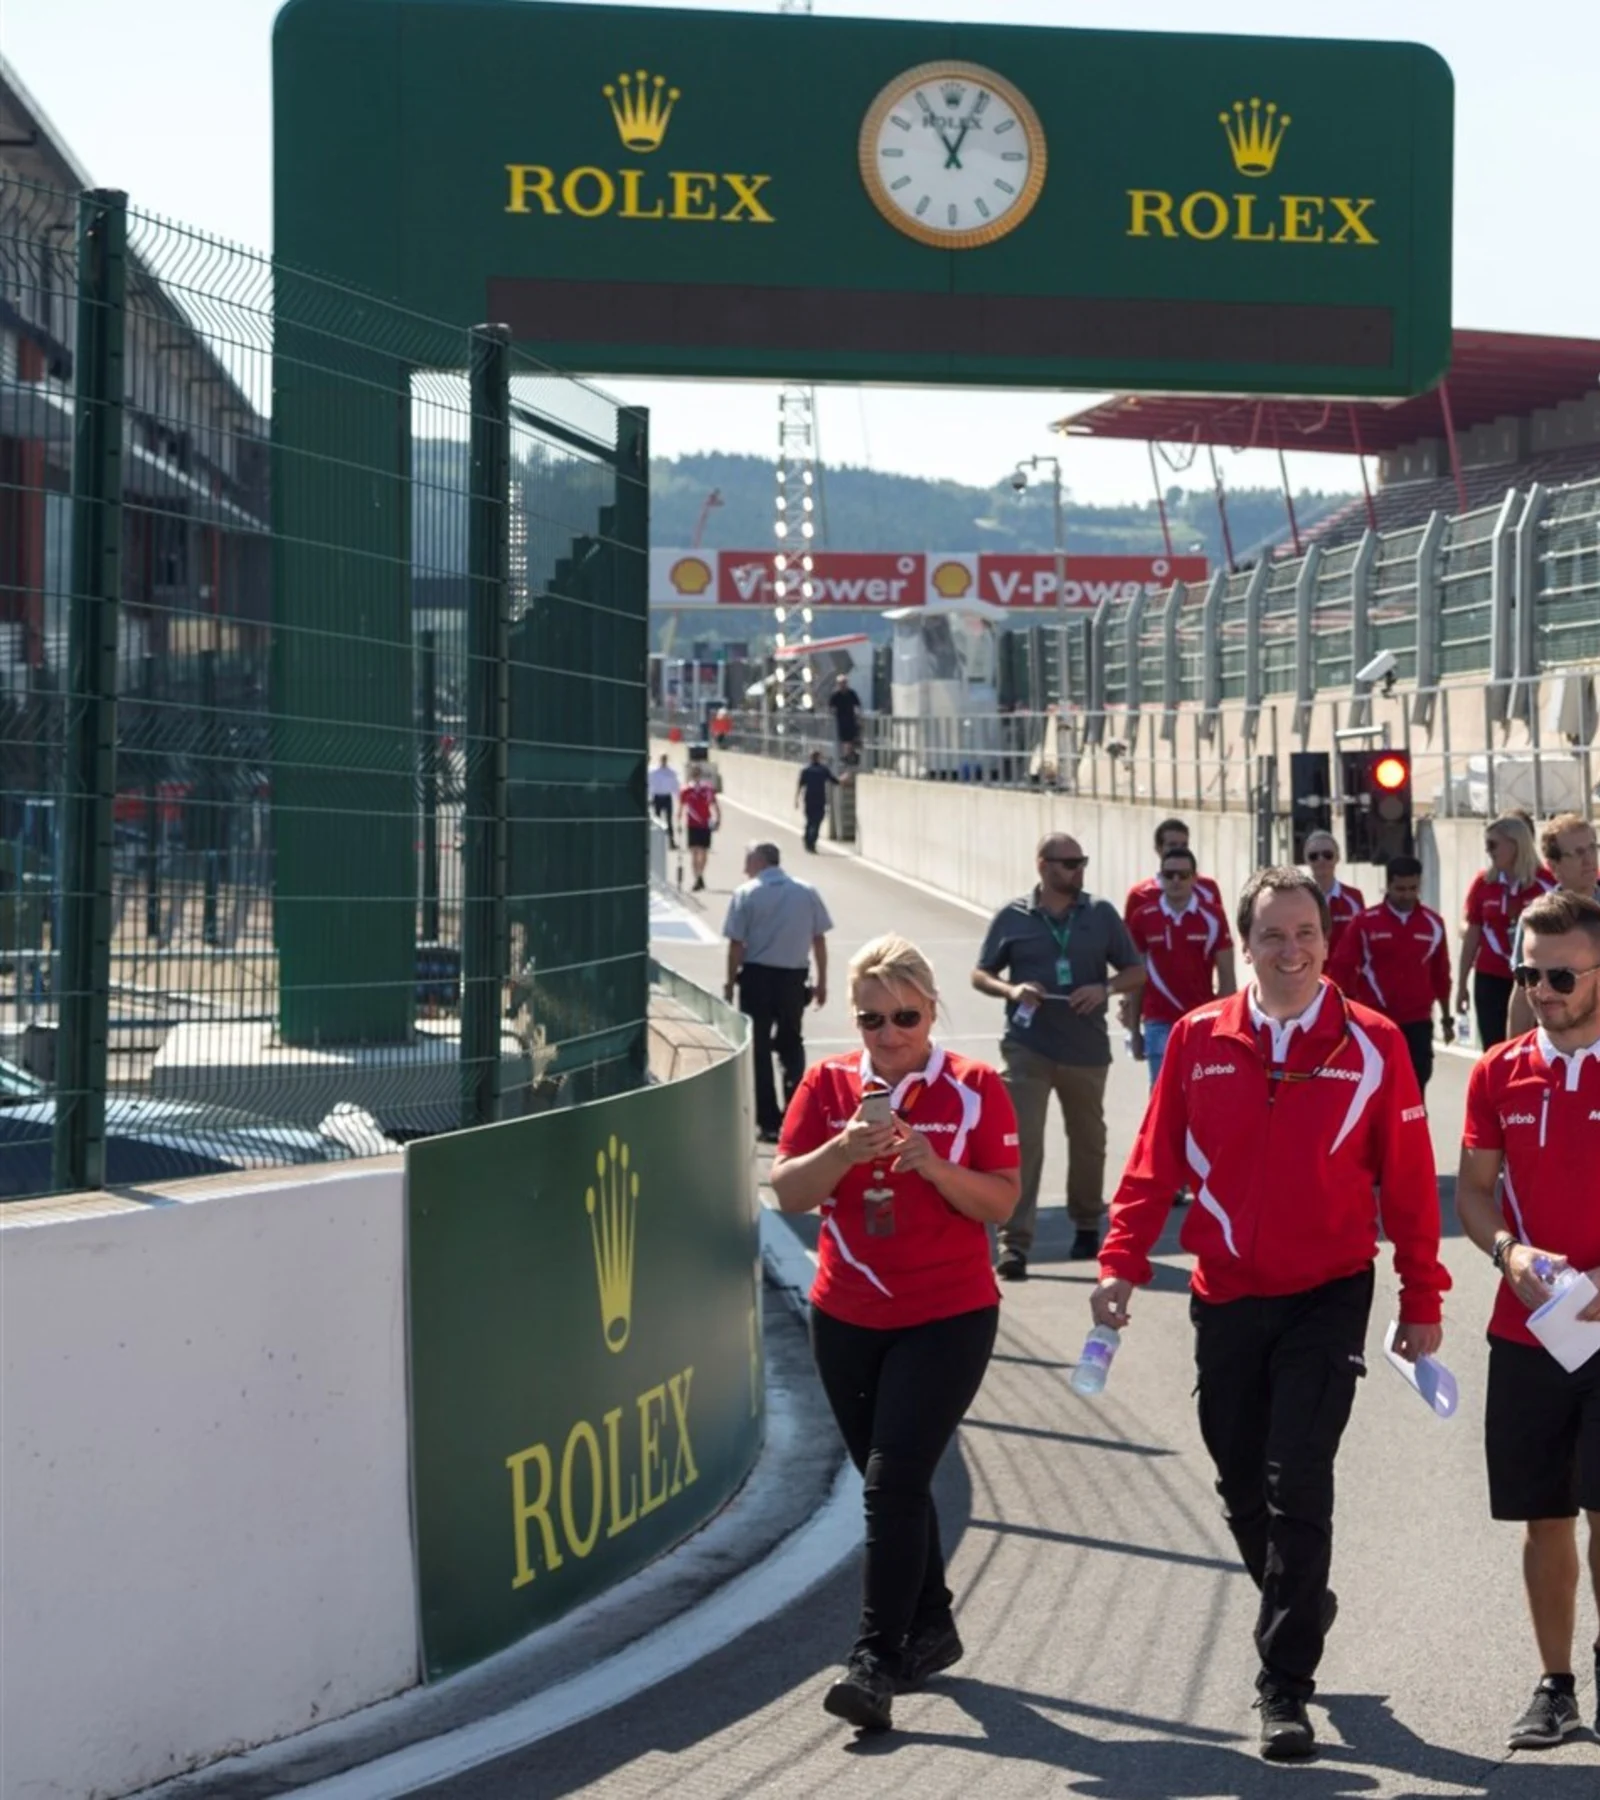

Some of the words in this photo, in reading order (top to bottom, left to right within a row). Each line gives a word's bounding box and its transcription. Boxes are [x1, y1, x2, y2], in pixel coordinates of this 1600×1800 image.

[504, 164, 776, 222] ROLEX
[1126, 190, 1379, 244] ROLEX
[1204, 1063, 1236, 1076] airbnb
[1506, 1112, 1535, 1126] airbnb
[505, 1365, 700, 1590] ROLEX
